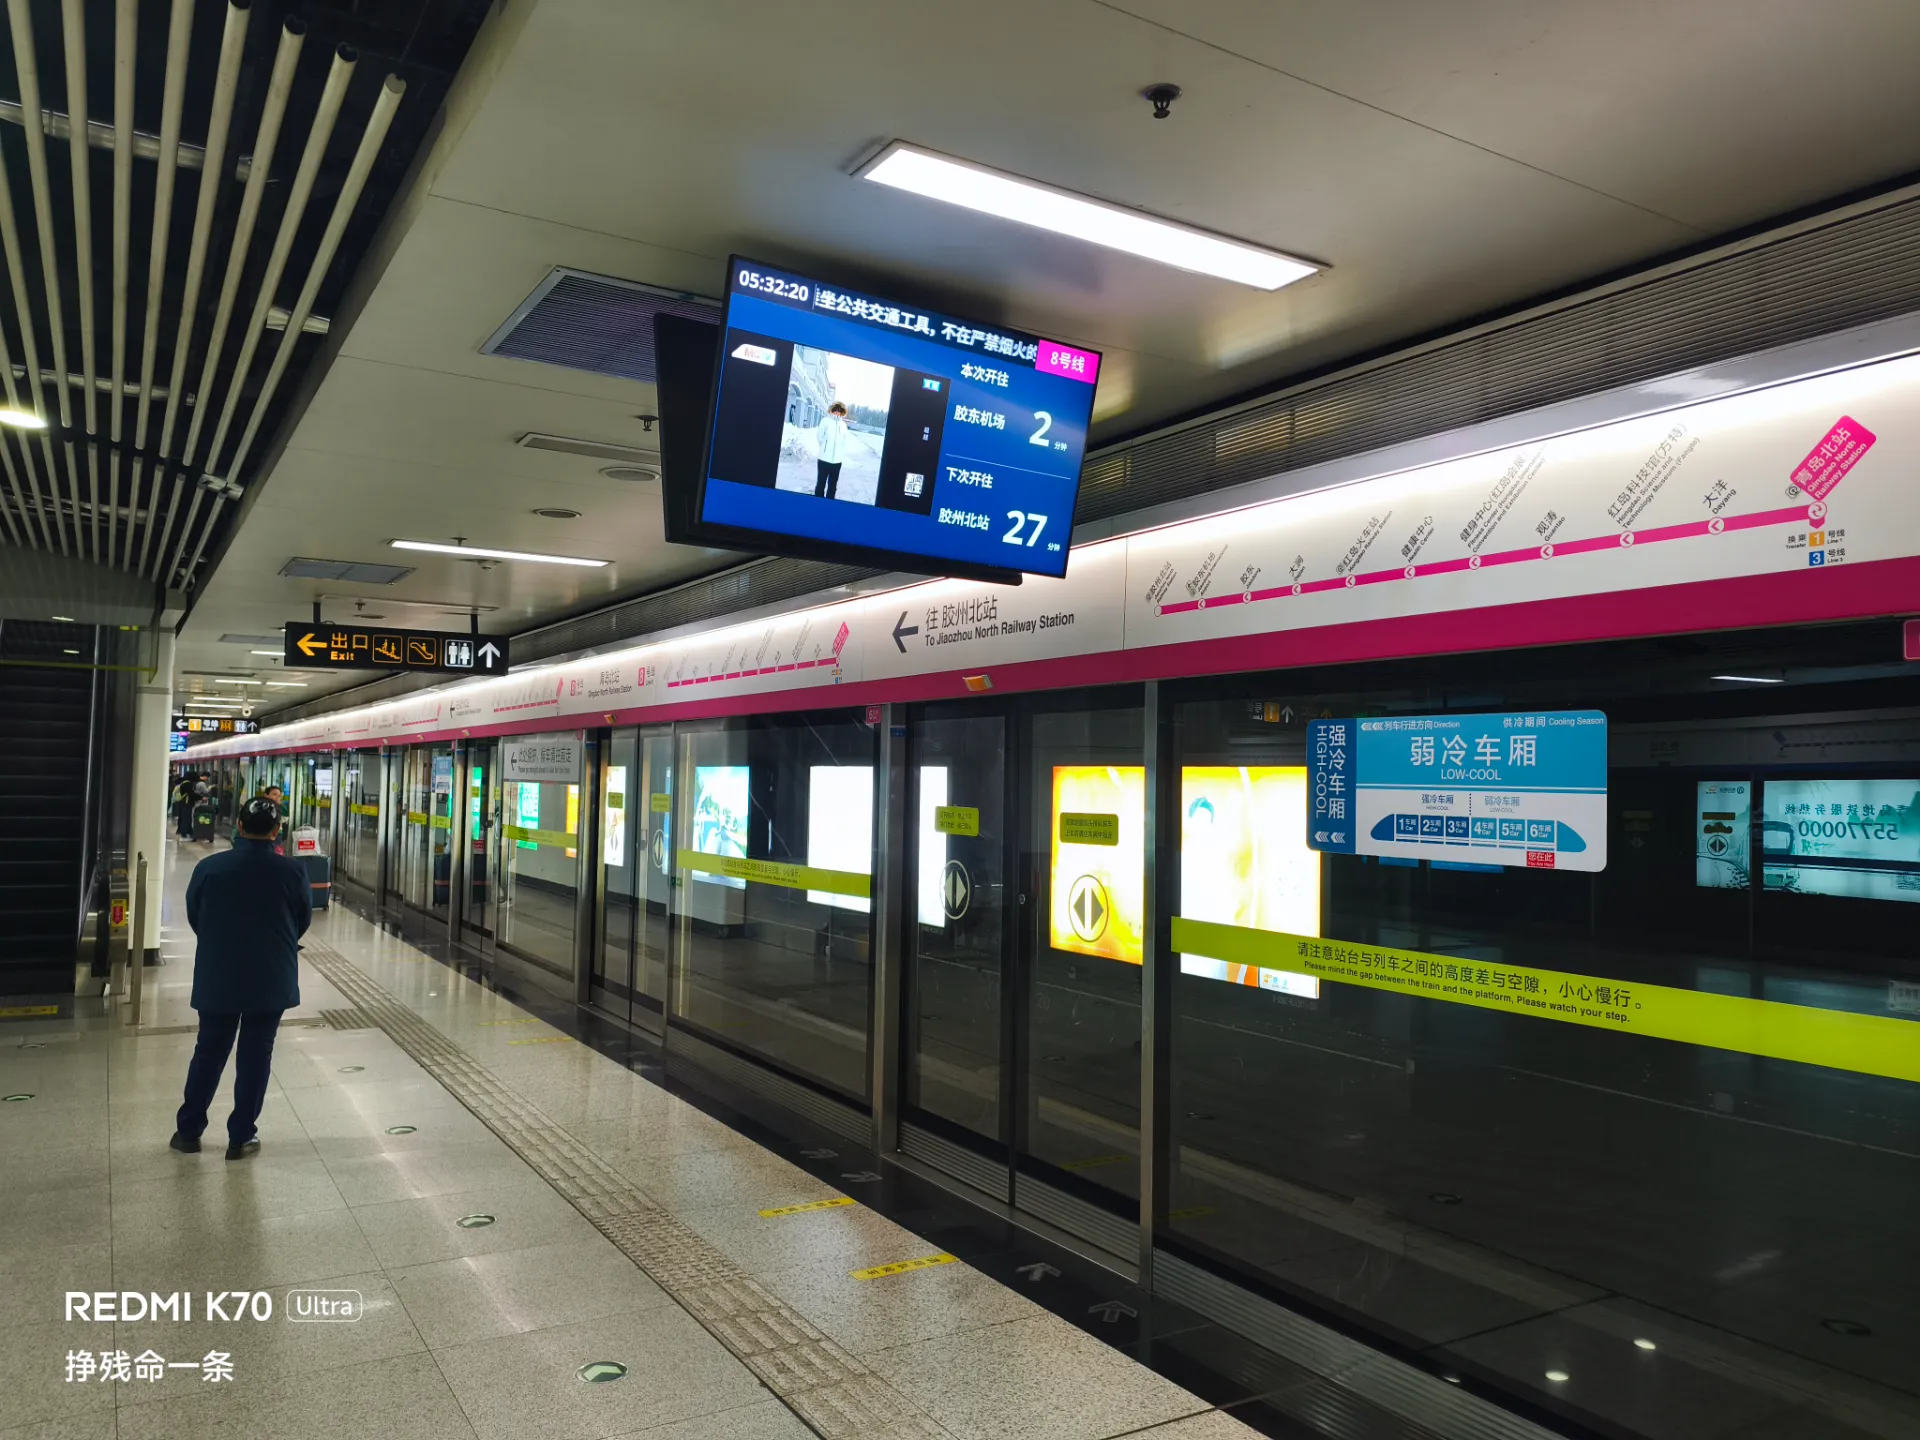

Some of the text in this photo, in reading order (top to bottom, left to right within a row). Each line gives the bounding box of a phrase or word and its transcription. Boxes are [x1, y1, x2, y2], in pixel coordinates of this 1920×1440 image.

[739, 270, 809, 302] 05:32:20
[960, 362, 1010, 388] 本次开往
[1050, 351, 1085, 373] 8号线
[953, 405, 1006, 430] 胶东机场
[1029, 411, 1053, 447] 2
[1054, 442, 1068, 451] 分钟
[1794, 427, 1852, 486] 青岛北站
[946, 466, 994, 489] 下次开往
[1807, 440, 1857, 492] Qingdao North
[1814, 442, 1868, 499] Railway Station
[1616, 456, 1674, 524] Hongdao Science and
[1622, 493, 1655, 530] Technology
[1652, 465, 1678, 494] Museum
[1702, 479, 1729, 509] 大洋
[1711, 488, 1737, 515] Dayang
[938, 508, 990, 531] 胶州北站
[1002, 510, 1048, 547] 27
[1467, 527, 1485, 549] Fitness
[1483, 508, 1499, 528] Center
[1472, 521, 1498, 553] Convention
[1497, 509, 1507, 522] and
[1505, 480, 1529, 510] Exhibition
[1535, 510, 1558, 536] 观涛
[1544, 516, 1566, 542] Guantao
[1047, 543, 1061, 552] 分钟
[1342, 516, 1380, 568] 红岛火车站
[1401, 515, 1434, 557] 健康中心
[1812, 552, 1821, 565] 3
[941, 594, 999, 629] 胶州北站
[331, 632, 368, 650] 出口
[925, 612, 1075, 648] To Jiaozhou North Railway Station
[330, 651, 354, 661] Exit
[1384, 720, 1433, 731] 列车行进方向
[1434, 720, 1460, 729] Direction
[1503, 716, 1546, 728] 供冷期间
[1549, 717, 1604, 727] Cooling Season
[1410, 734, 1537, 767] 弱冷车厢
[1316, 725, 1327, 819] HIGH-COOL
[1328, 725, 1346, 819] 强冷车厢
[1441, 769, 1502, 781] LOW-COOL
[1421, 794, 1454, 805] 强冷车厢
[1484, 795, 1520, 807] 弱冷车厢
[1422, 820, 1430, 832] 2
[1447, 821, 1455, 833] 3
[1473, 822, 1481, 835] 4
[1502, 823, 1509, 836] 5
[1529, 824, 1538, 838] 6
[1297, 941, 1642, 1010] 请注意站台与列车之间的高度差与空隙，小心慢行。
[1304, 960, 1630, 1023] Please mind the gap between the train and the platform, Please watch your step.
